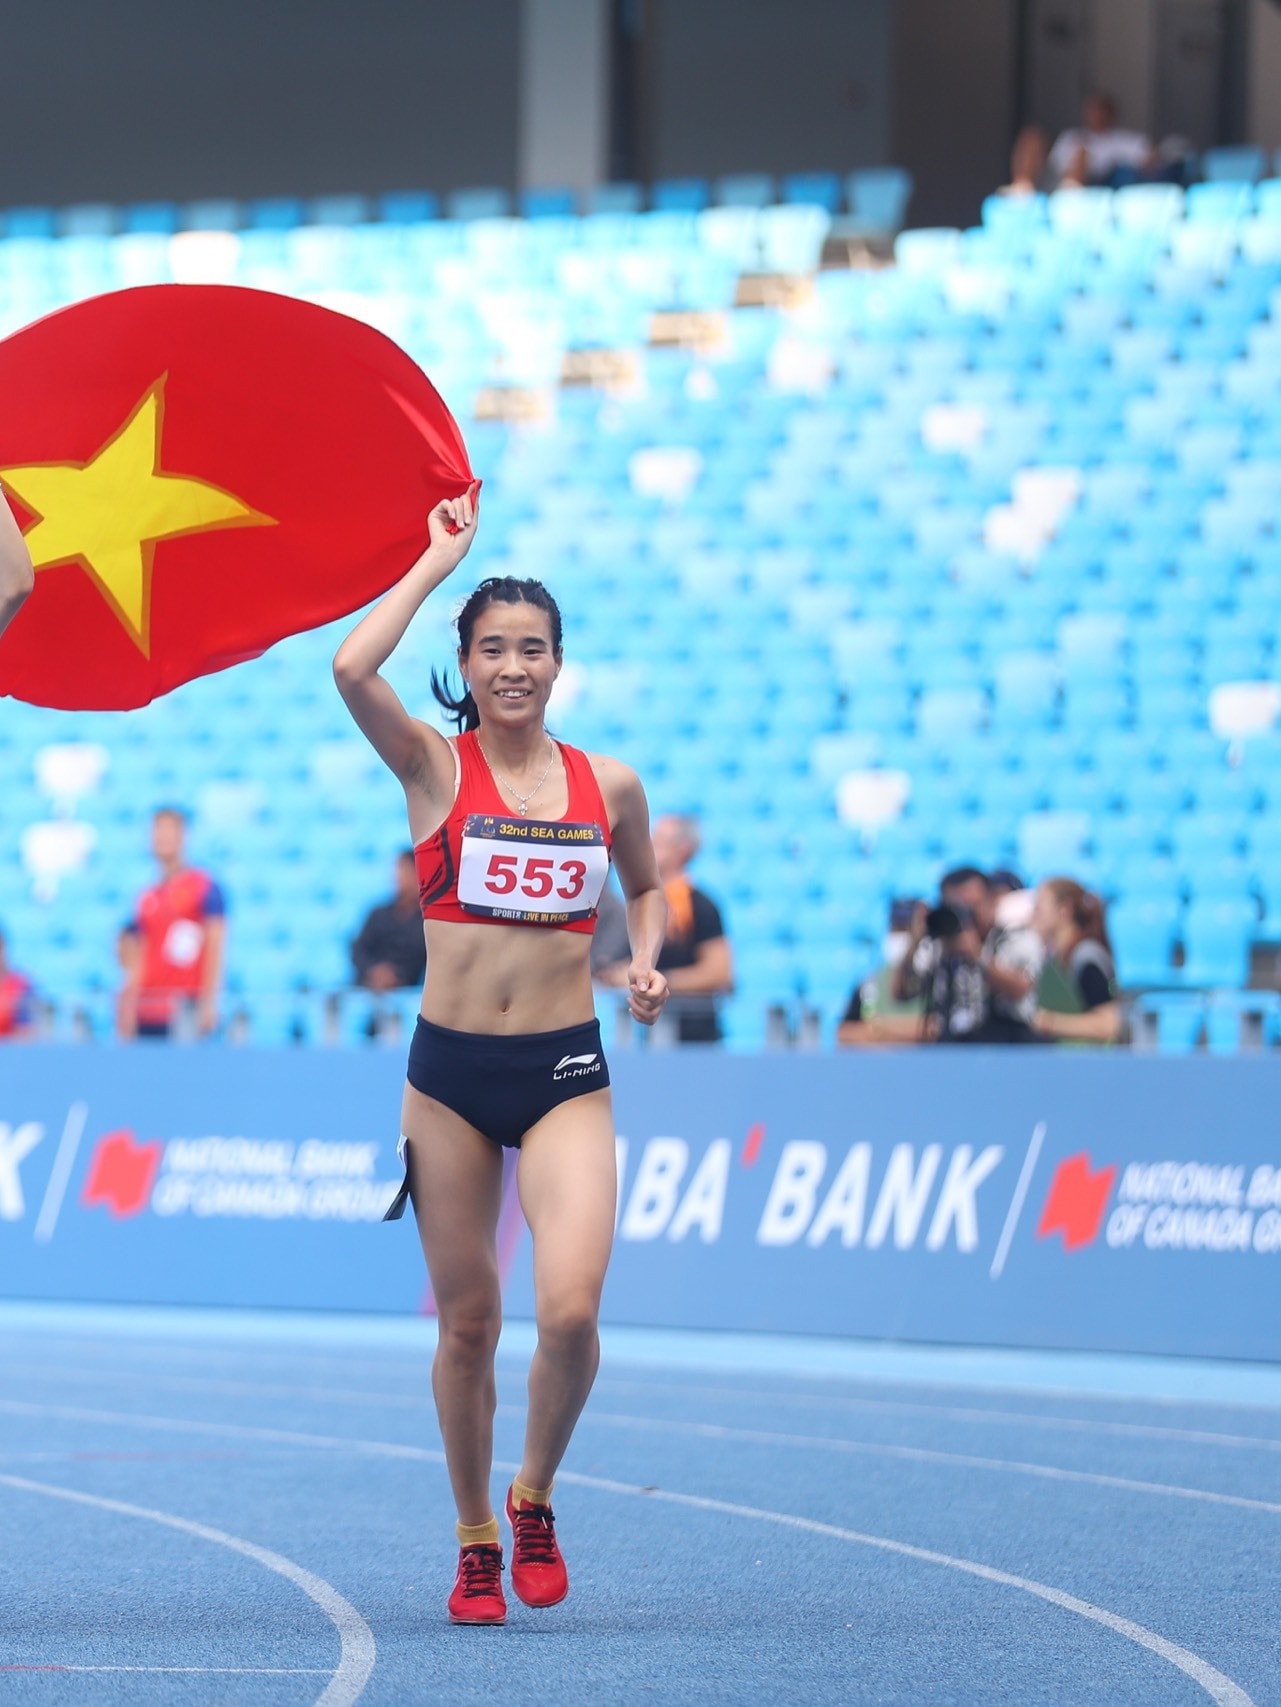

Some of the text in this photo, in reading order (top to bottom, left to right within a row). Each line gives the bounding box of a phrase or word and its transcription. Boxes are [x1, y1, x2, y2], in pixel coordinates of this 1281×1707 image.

[499, 824, 528, 837] 32nd
[530, 826, 554, 839] SEA
[557, 829, 594, 840] GAMES
[484, 854, 587, 900] 553
[523, 911, 539, 921] LIVE
[540, 912, 549, 922] IN
[550, 912, 569, 922] PEACE
[553, 1063, 601, 1080] LI-NING
[160, 1137, 376, 1177] NATIONAL BANK
[757, 1140, 1005, 1253] BANK
[1118, 1162, 1245, 1205] NATIONAL
[1106, 1204, 1150, 1248] OF
[1144, 1205, 1253, 1251] CANADA
